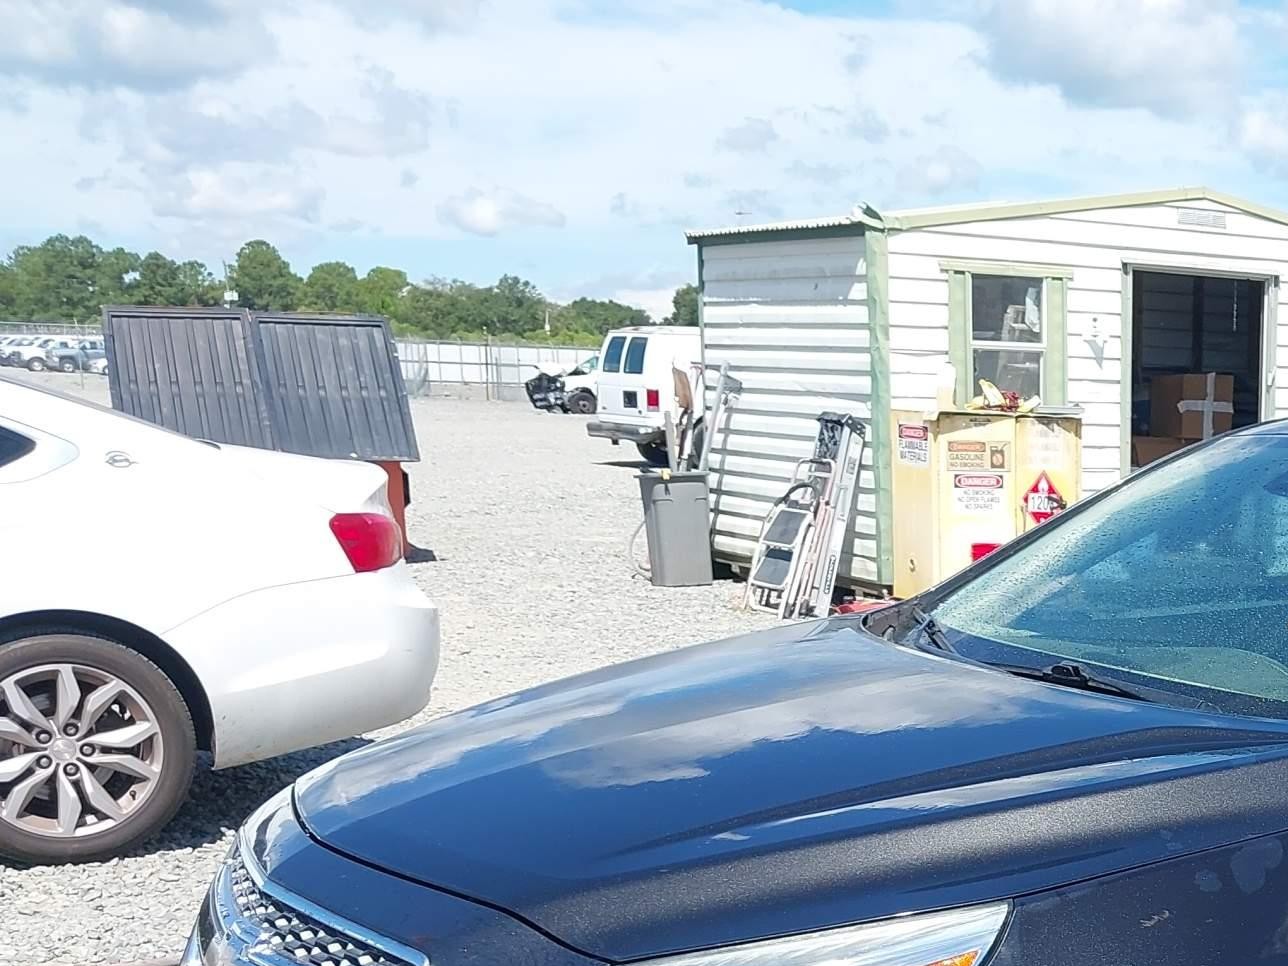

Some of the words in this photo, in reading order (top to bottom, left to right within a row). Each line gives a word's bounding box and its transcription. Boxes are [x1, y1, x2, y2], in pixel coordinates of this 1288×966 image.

[899, 439, 928, 452] FLAMMABLE
[949, 453, 985, 461] GASOLINE
[961, 476, 998, 486] DANGER
